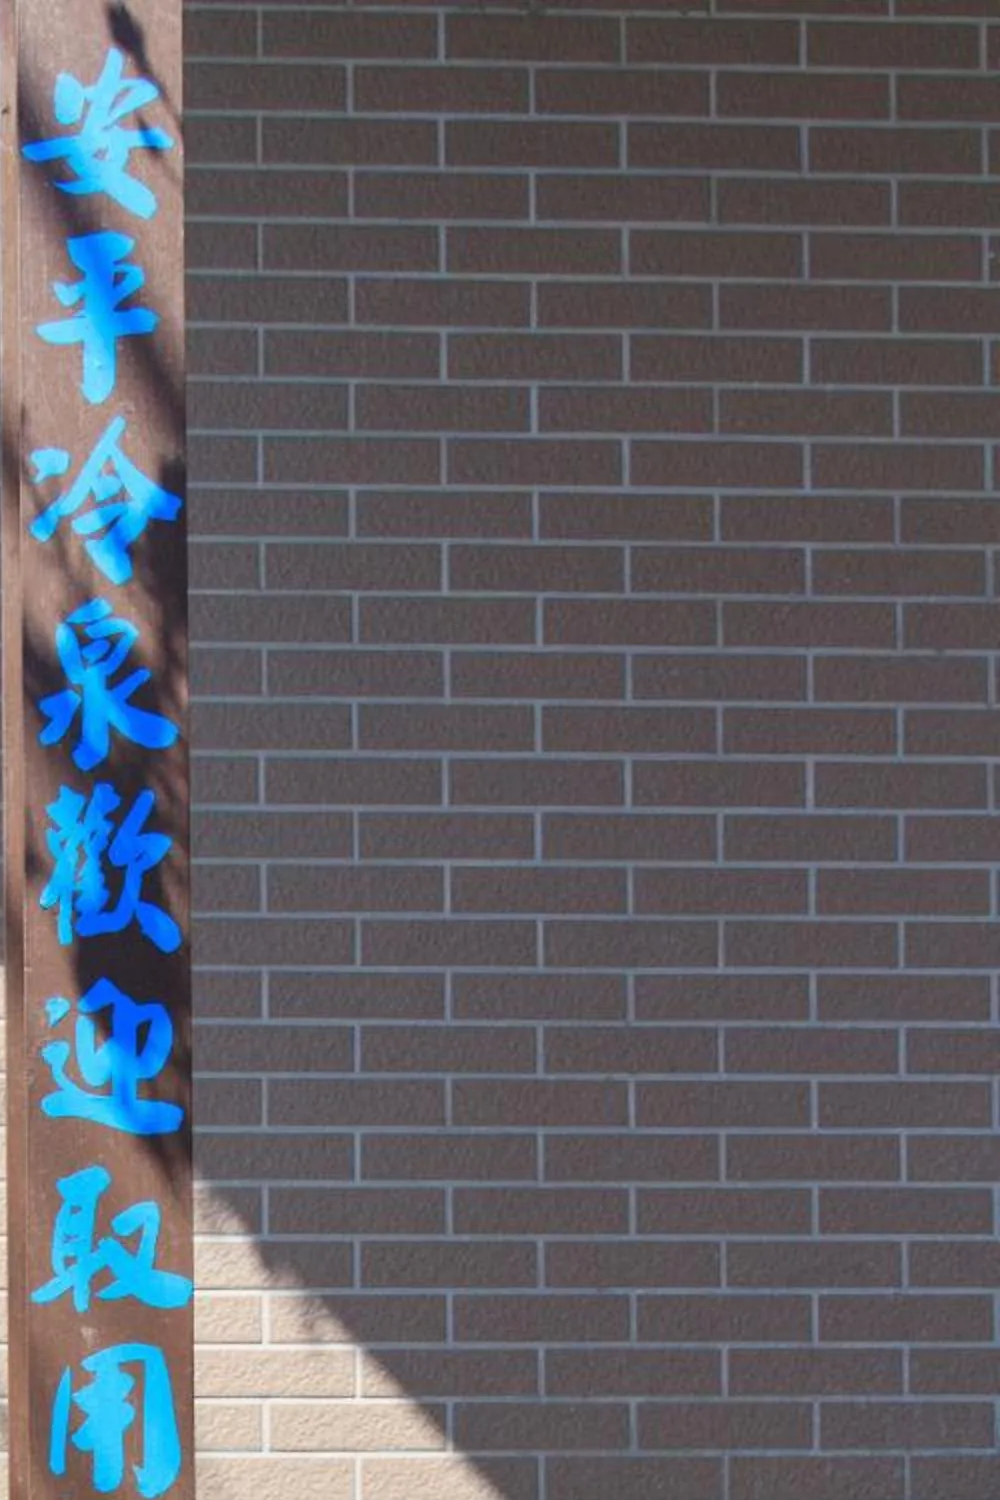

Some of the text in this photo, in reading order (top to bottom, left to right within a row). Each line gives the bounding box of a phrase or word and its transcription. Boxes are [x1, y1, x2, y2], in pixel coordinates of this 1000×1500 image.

[21, 47, 194, 1498] 安平冷泉歡迎取用
